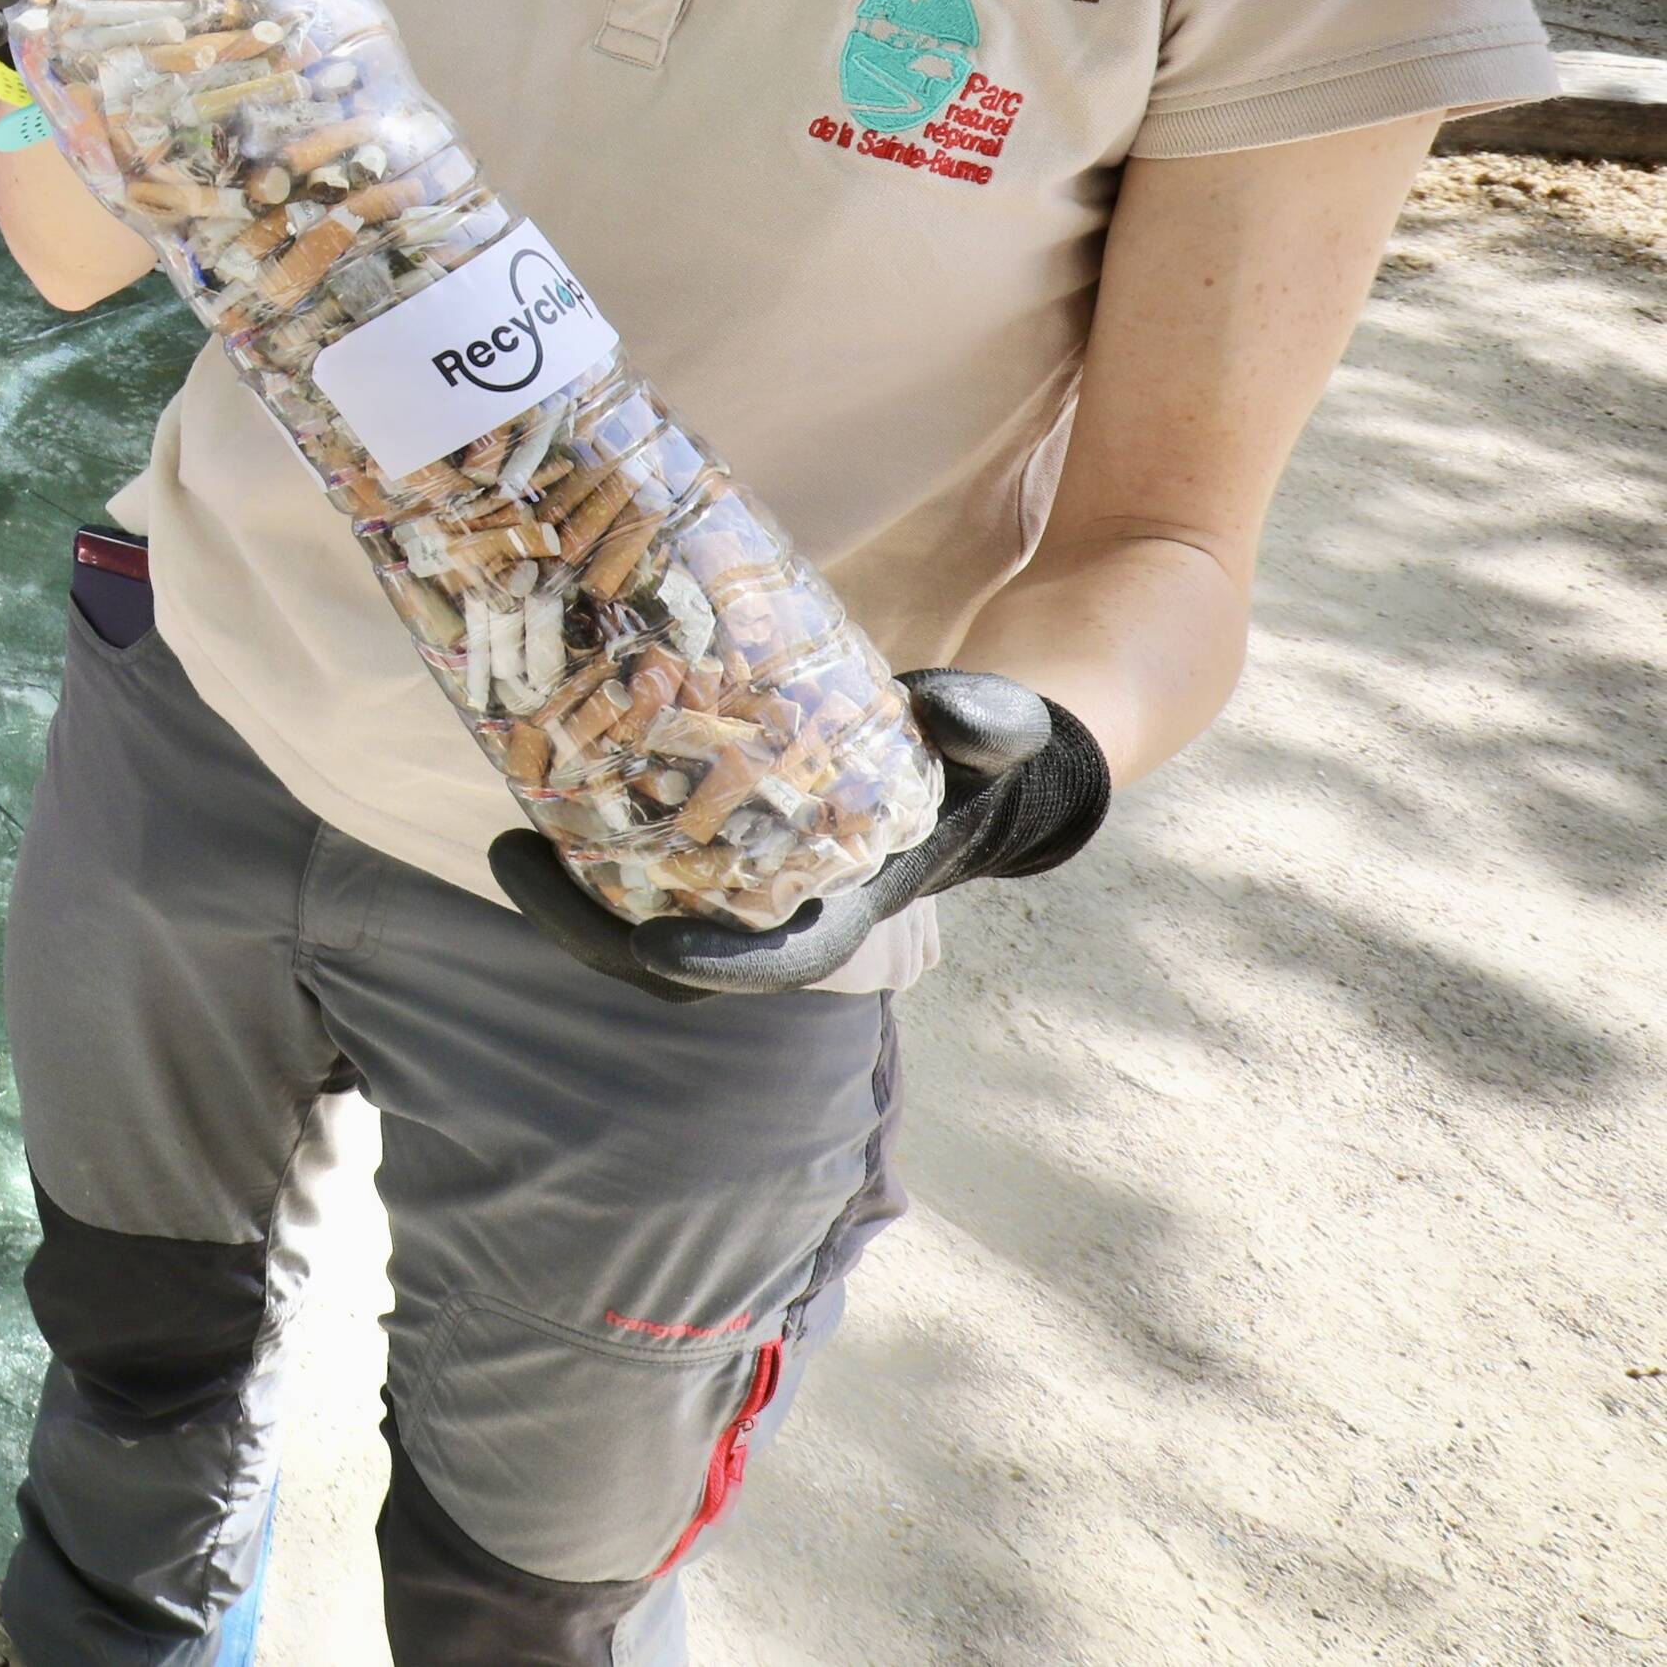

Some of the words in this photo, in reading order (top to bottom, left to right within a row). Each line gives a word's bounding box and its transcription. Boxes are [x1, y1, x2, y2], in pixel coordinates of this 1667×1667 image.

[959, 71, 1024, 118] Parc
[808, 114, 838, 143] de
[944, 102, 1014, 137] naturel
[922, 120, 1005, 159] régional
